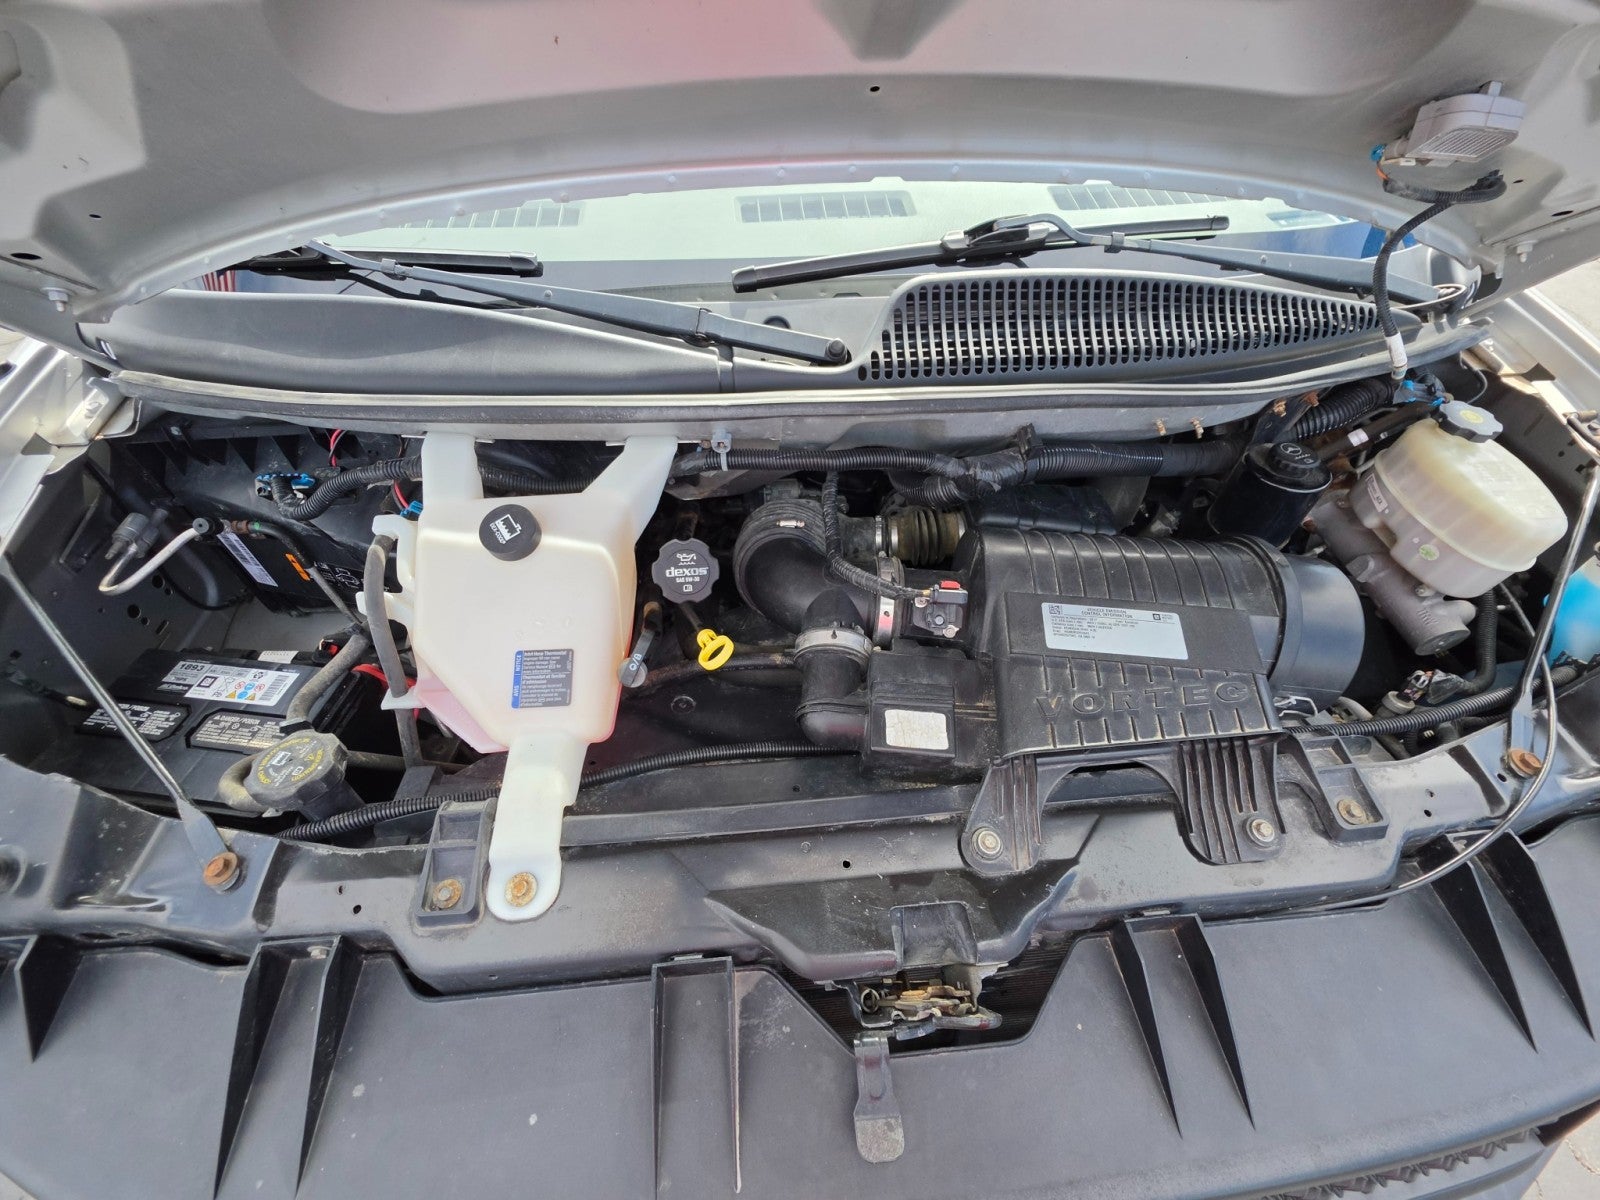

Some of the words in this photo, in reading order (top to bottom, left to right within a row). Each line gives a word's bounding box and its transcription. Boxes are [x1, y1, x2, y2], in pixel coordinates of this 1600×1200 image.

[665, 566, 708, 578] dexos
[180, 663, 205, 672] 1893
[1036, 681, 1249, 717] VORTEC
